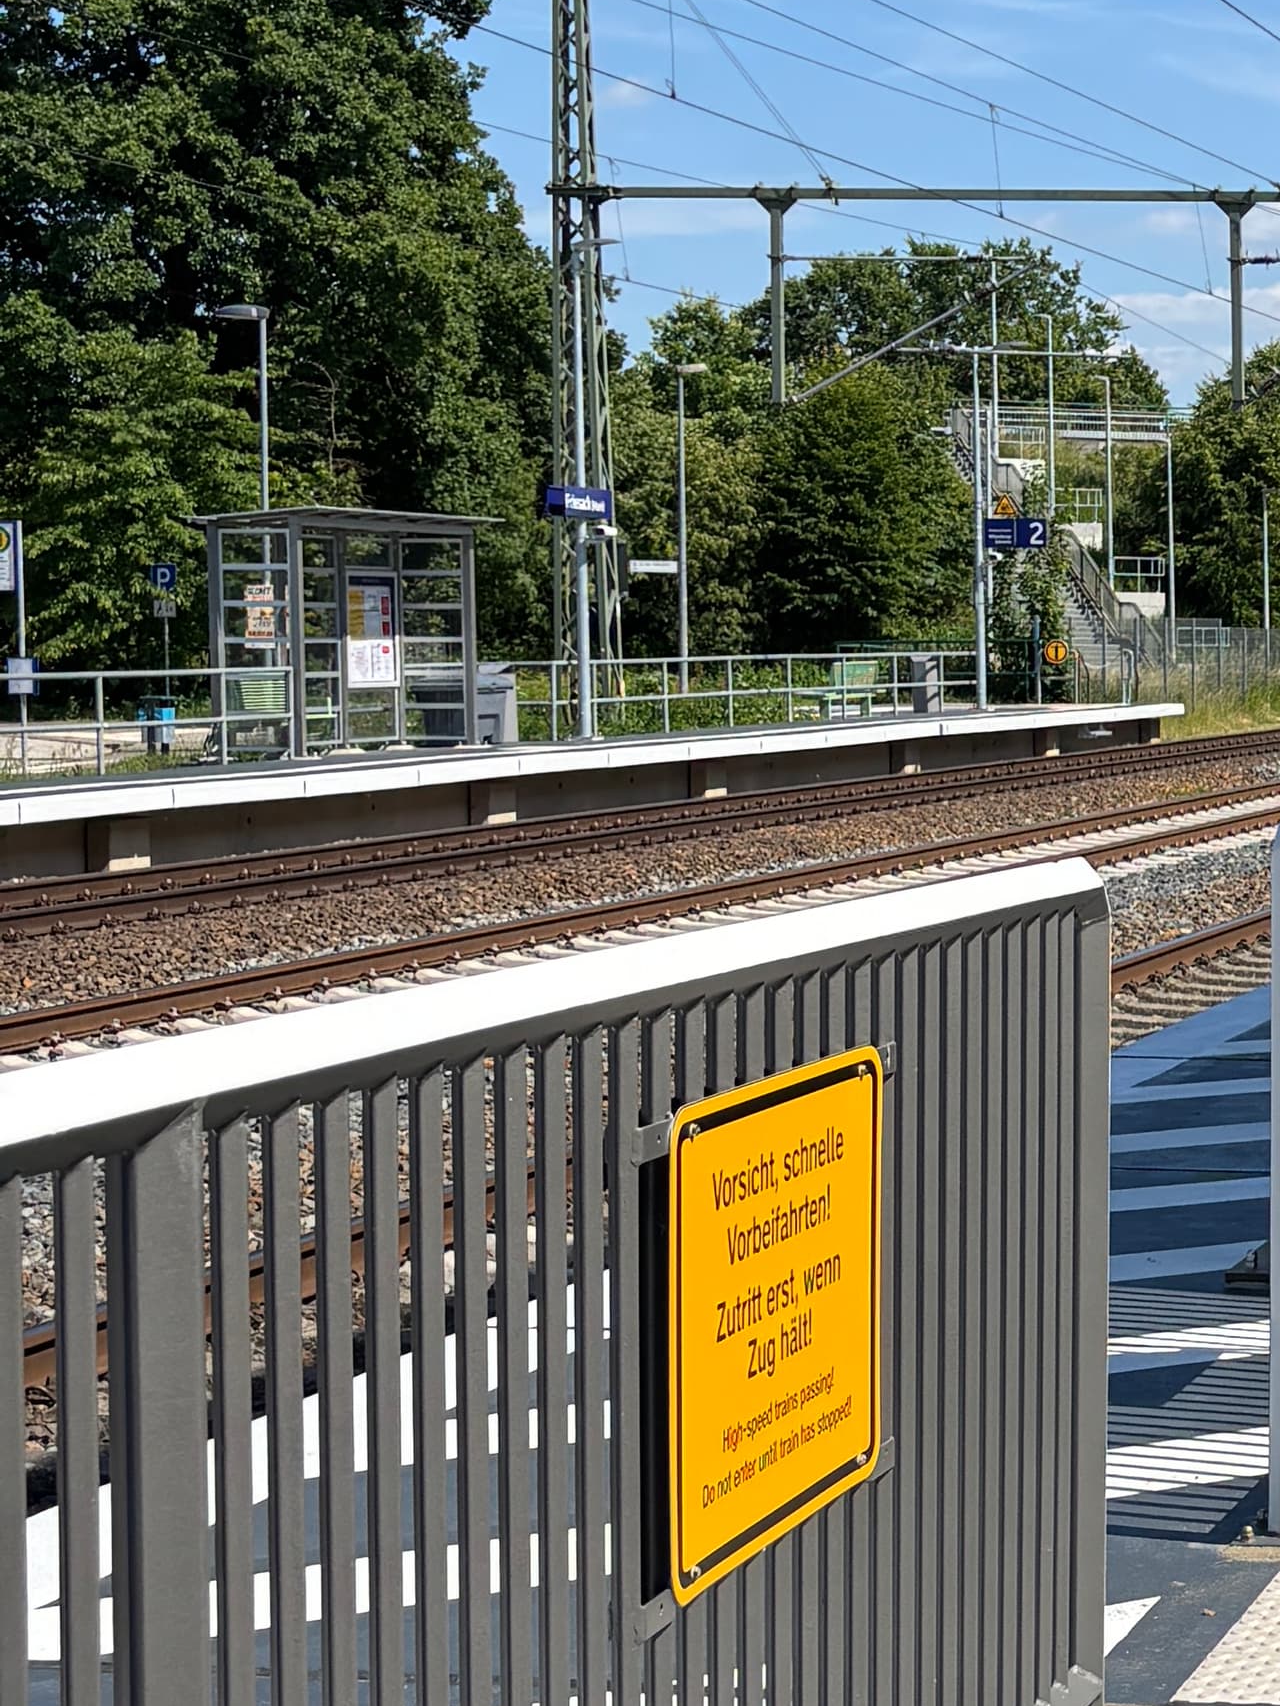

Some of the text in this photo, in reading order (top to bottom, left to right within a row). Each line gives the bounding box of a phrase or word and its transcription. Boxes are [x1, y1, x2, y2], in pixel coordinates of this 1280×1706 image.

[1029, 521, 1044, 545] 2
[157, 567, 171, 590] P
[712, 1125, 844, 1211] Vorsicht, schnelle
[727, 1182, 831, 1266] Vorbeifahrten!
[716, 1253, 841, 1343] Zutritt erst, wenn
[747, 1308, 812, 1380] Zug hält!
[702, 1394, 853, 1509] Do not enter until train has stopped!
[722, 1365, 835, 1453] High-speed trains passing!
